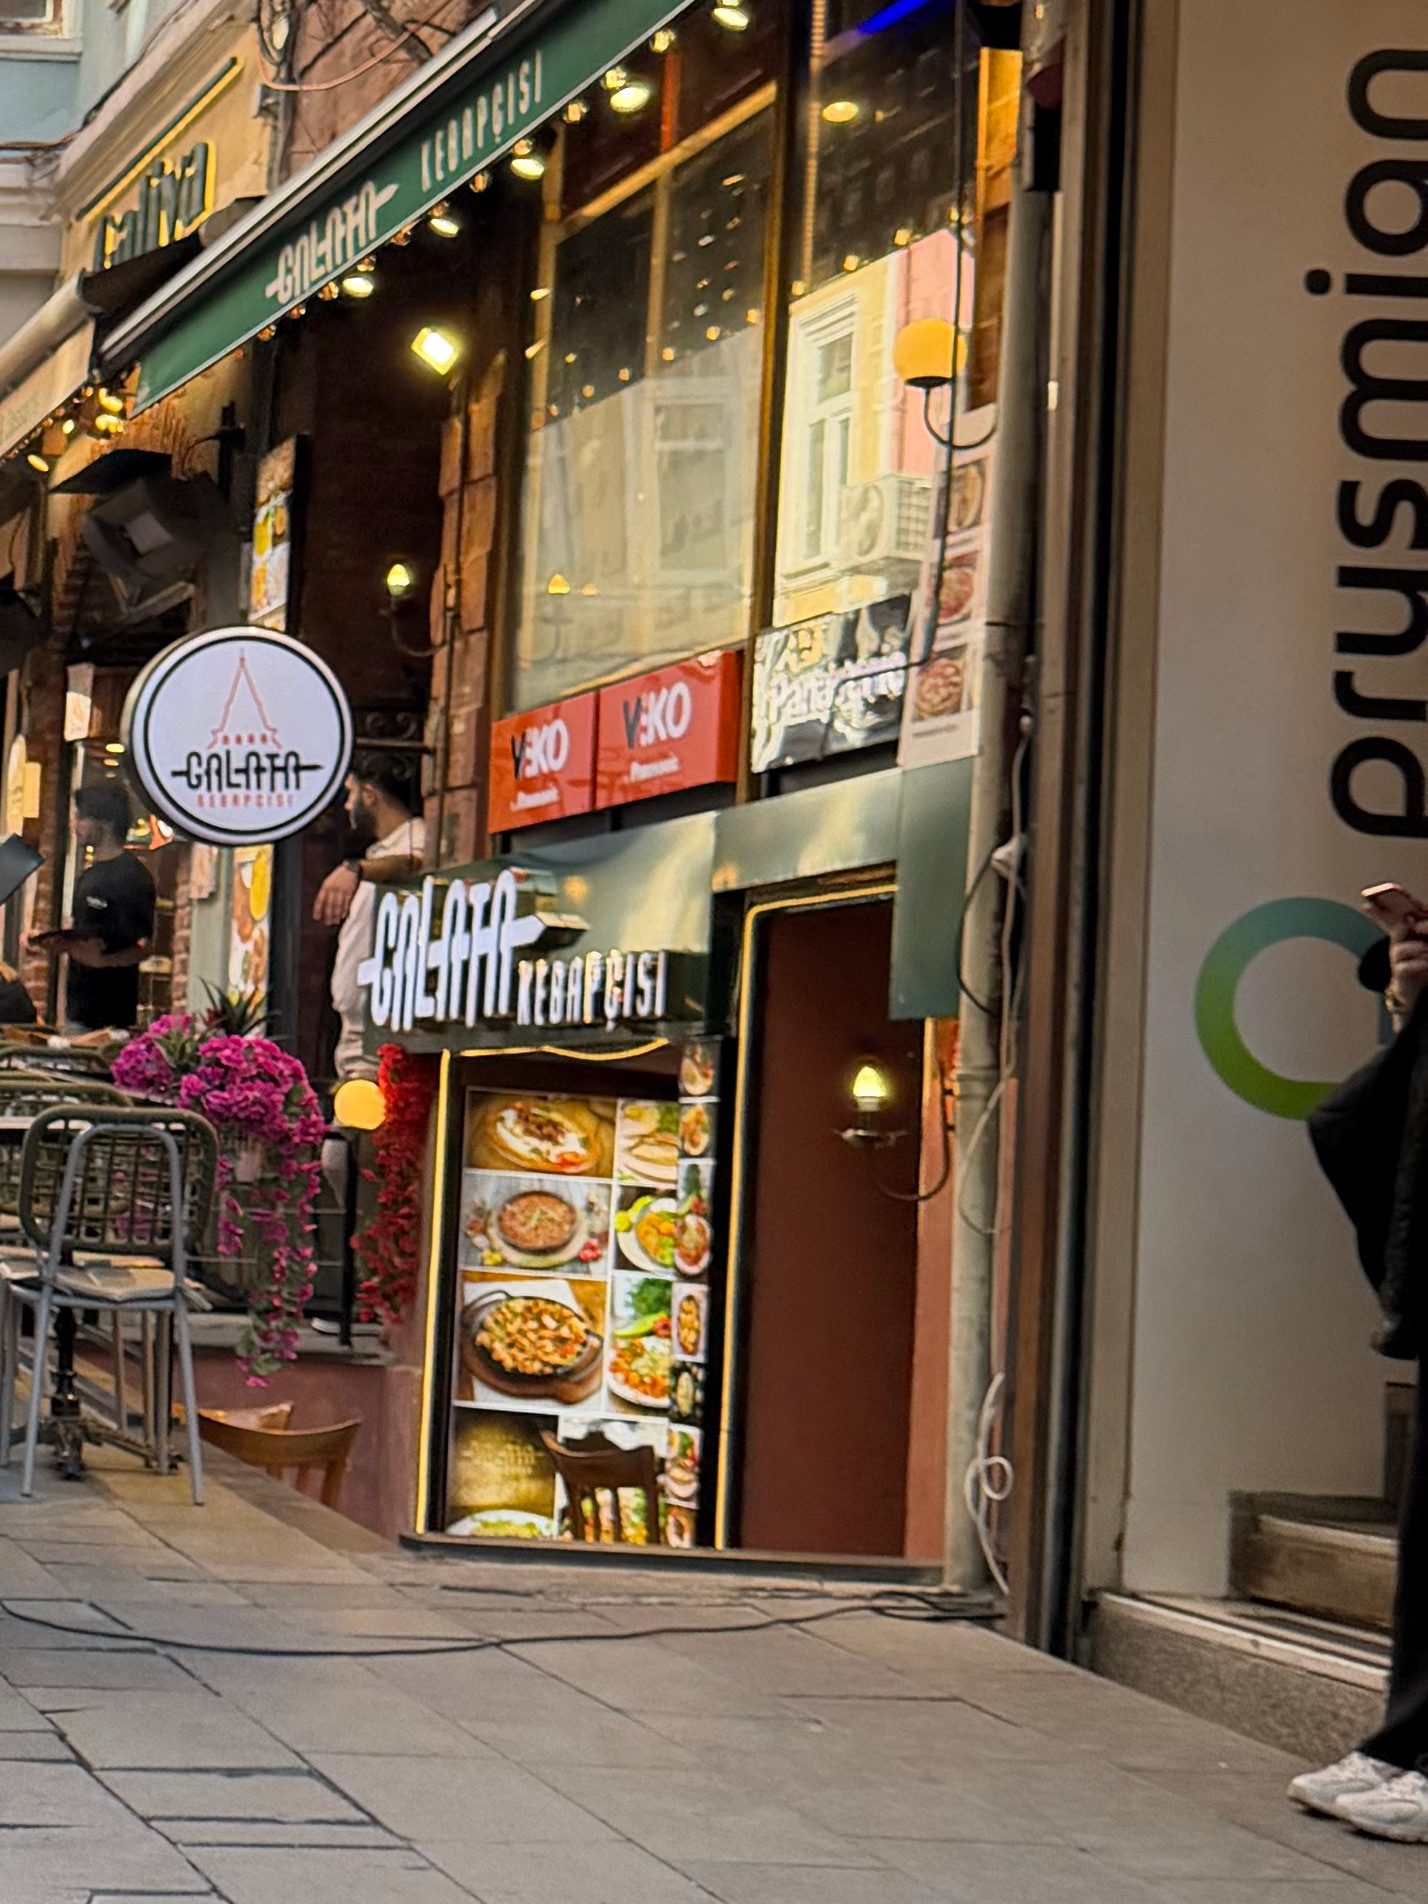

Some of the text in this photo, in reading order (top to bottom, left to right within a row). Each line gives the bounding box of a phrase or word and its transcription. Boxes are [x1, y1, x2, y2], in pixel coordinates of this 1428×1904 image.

[266, 180, 396, 304] GALATA
[173, 749, 321, 792] GALATA
[357, 868, 668, 1031] GALATA KEBAPÇISI
